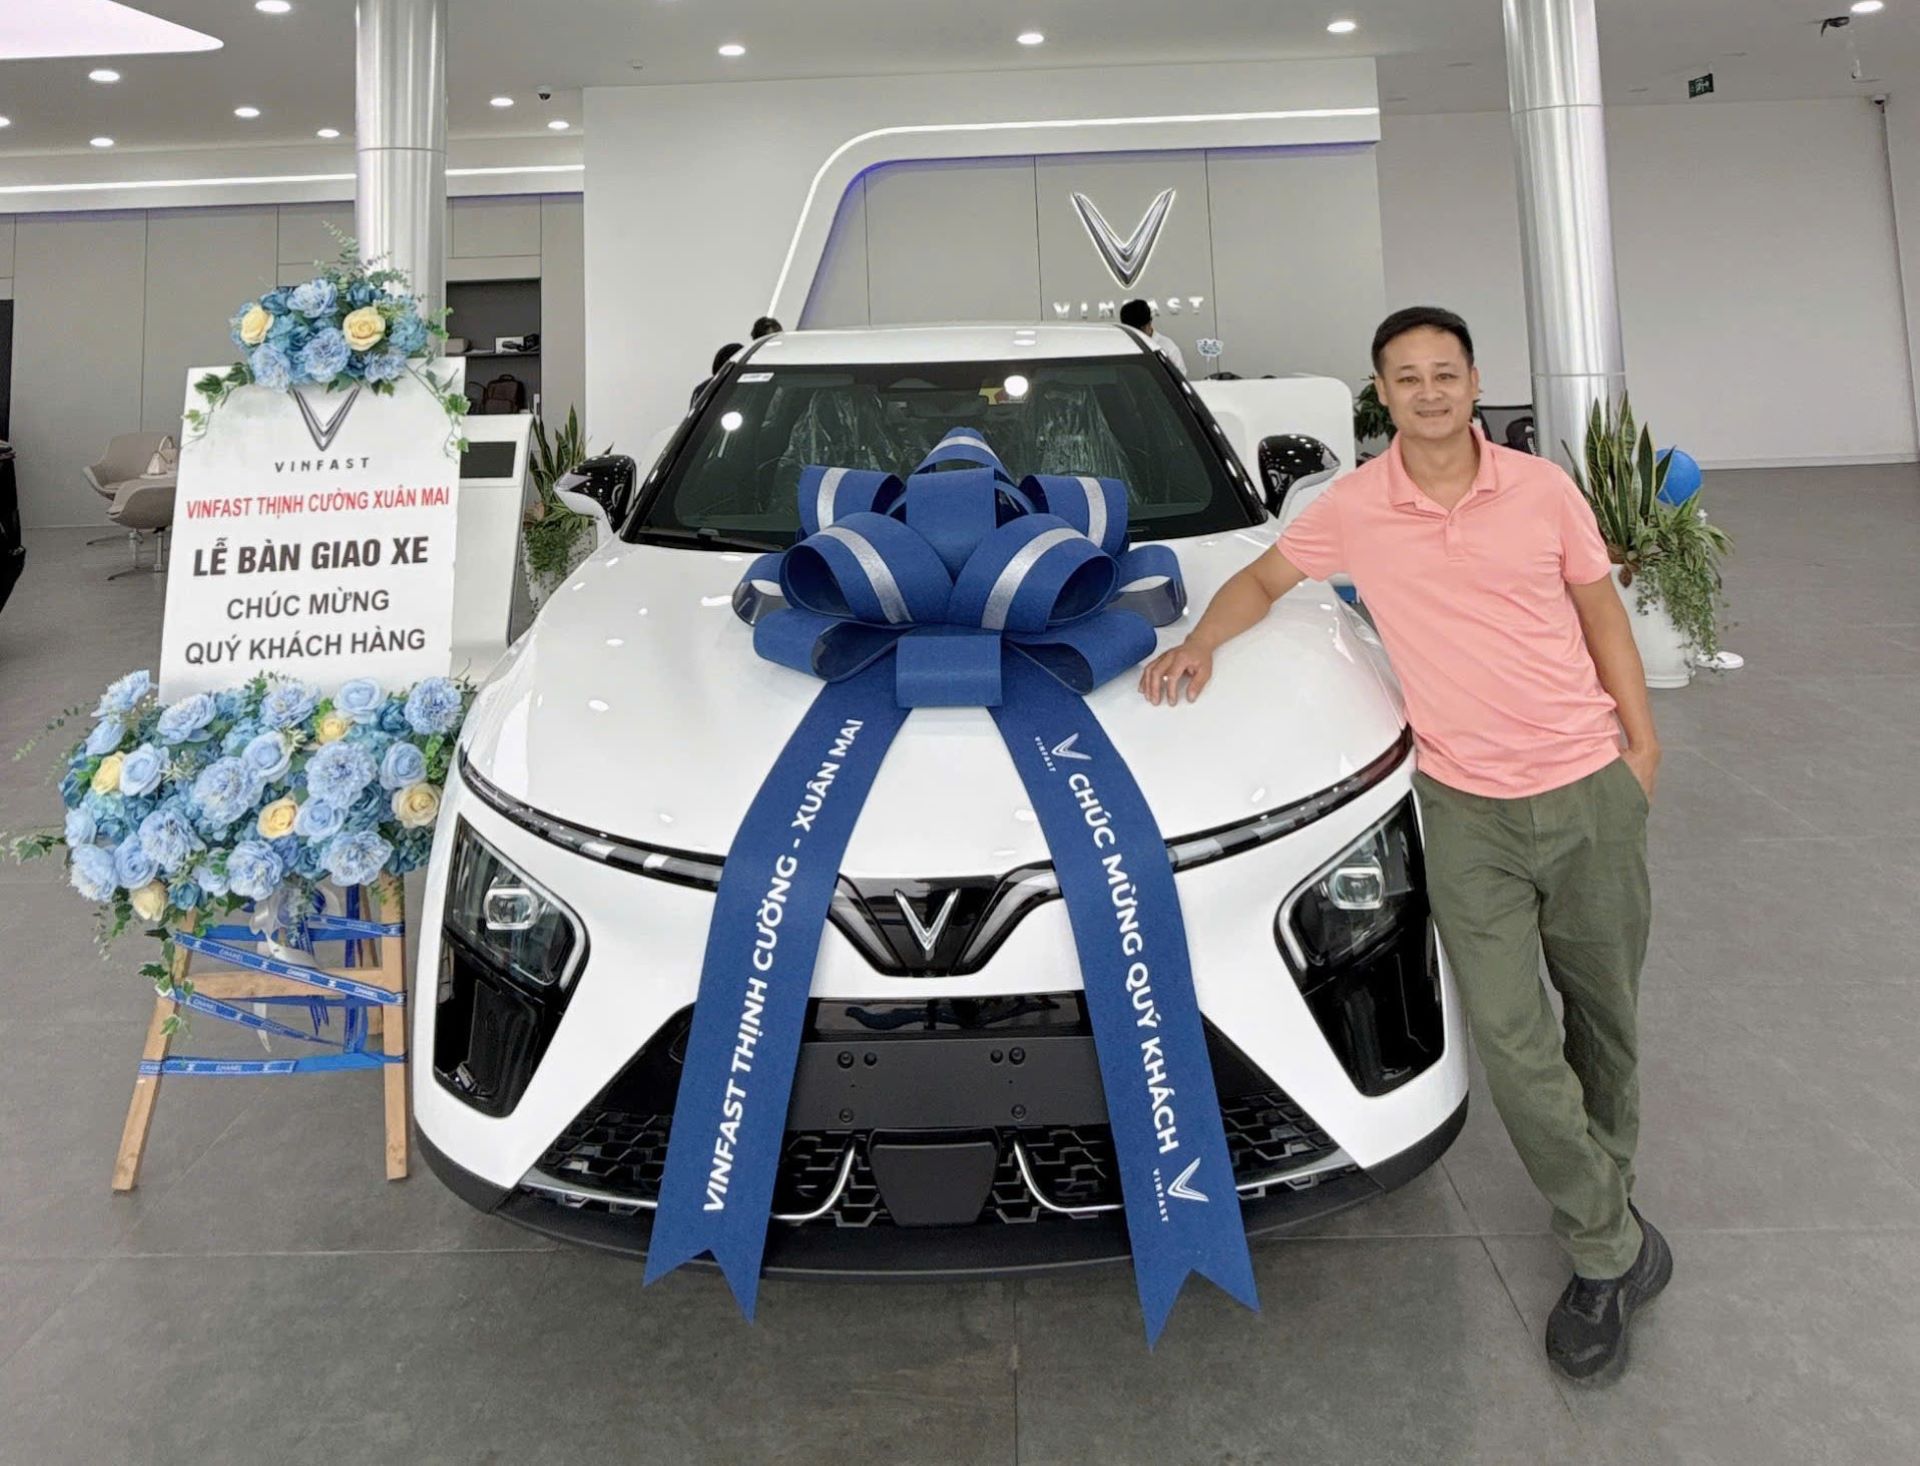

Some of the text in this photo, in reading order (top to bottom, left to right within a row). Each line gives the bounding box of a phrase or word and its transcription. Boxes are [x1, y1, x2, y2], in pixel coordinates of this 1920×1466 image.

[1053, 297, 1204, 317] VINAST
[274, 457, 370, 473] VINFAST
[187, 485, 450, 519] VINFAST THỊNH CƯỜNG XUÂN MAI
[193, 536, 429, 577] LỄ BÀN GIAO XE
[226, 586, 390, 620] CHÚC MỪNG
[185, 627, 426, 665] QUÝ KHÁCH HÀNG
[703, 1077, 747, 1211] VINFAST
[731, 977, 768, 1074] THỊNH
[752, 855, 799, 971] CƯỜNG
[791, 761, 841, 833] XUÂN
[828, 718, 864, 758] MAI
[1068, 772, 1180, 1155] CHÚC MỪNG QUÝ KHÁCH
